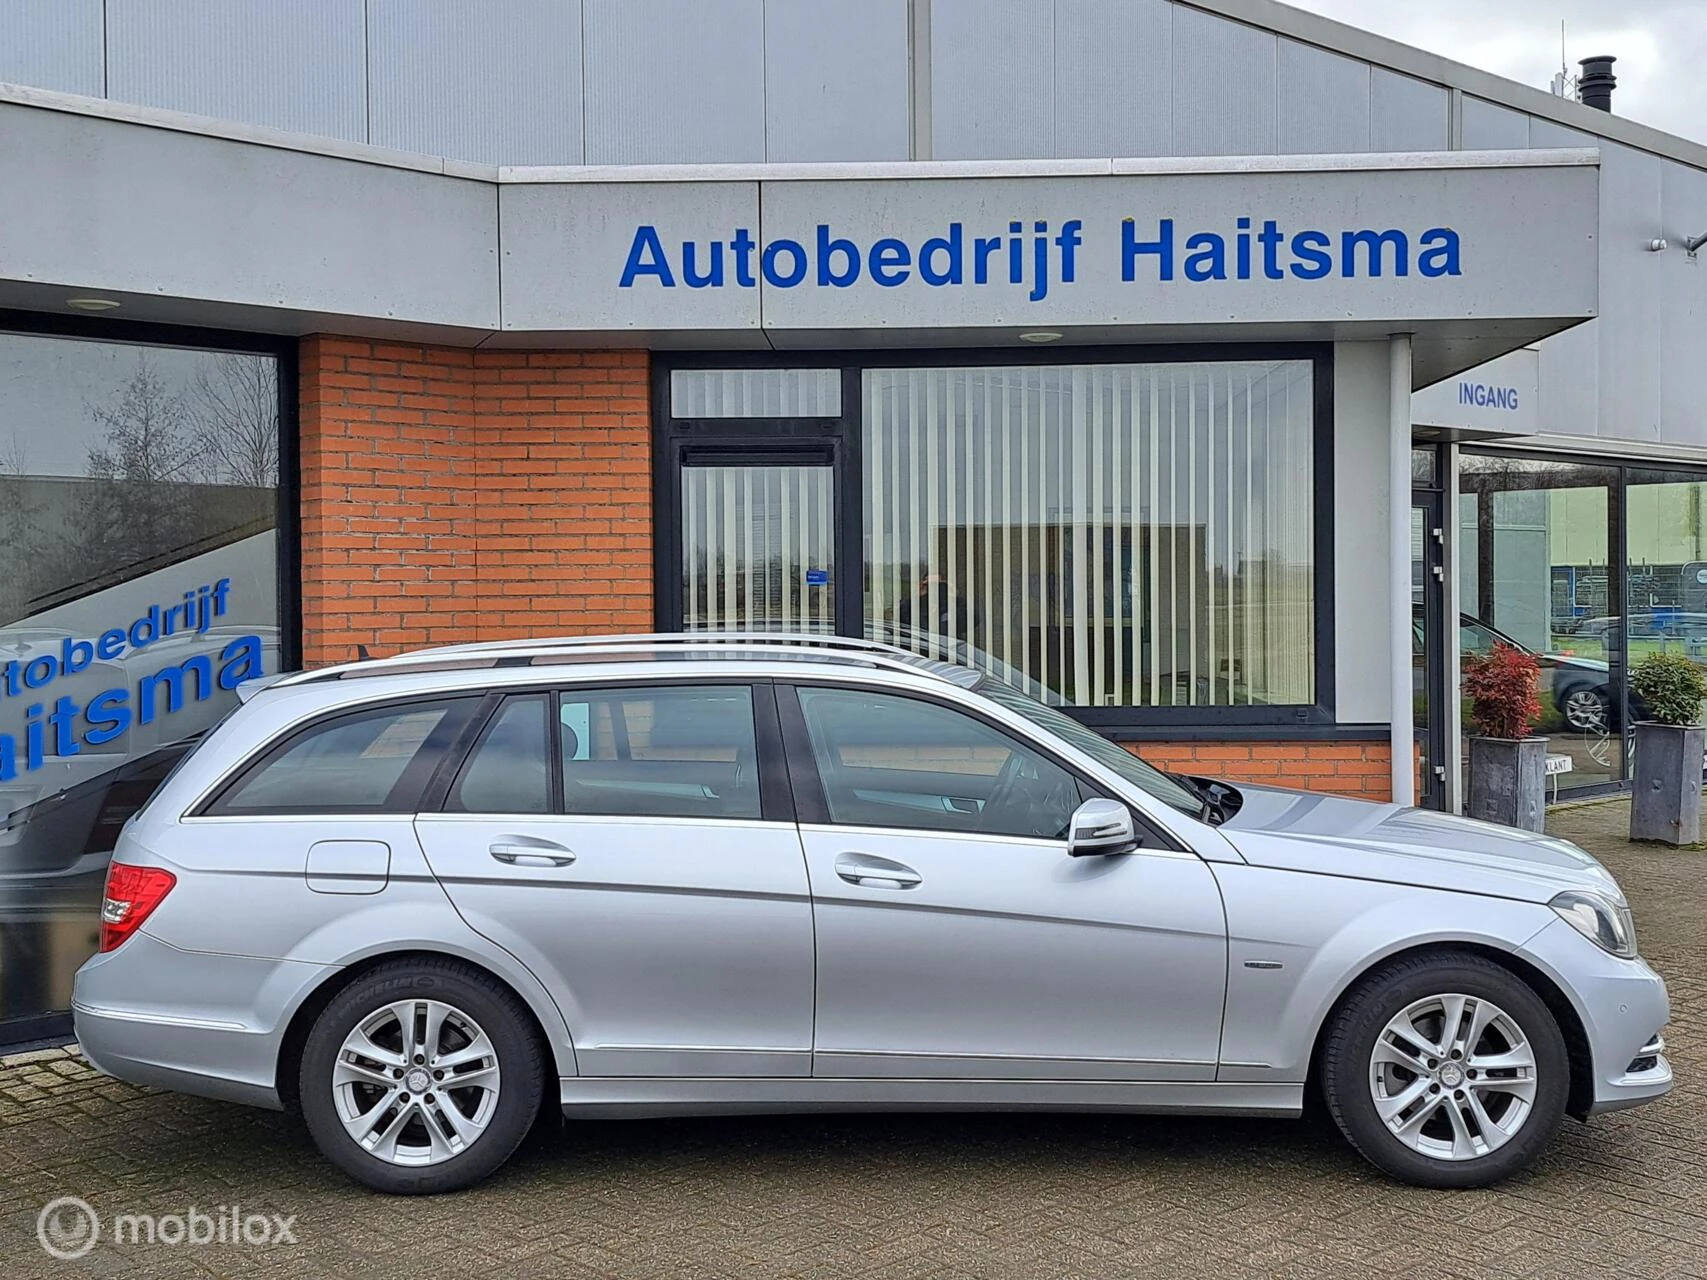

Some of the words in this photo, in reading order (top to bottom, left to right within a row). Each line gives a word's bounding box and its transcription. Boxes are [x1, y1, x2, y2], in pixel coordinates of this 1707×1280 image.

[618, 219, 1082, 302] Autobedrijf
[1121, 217, 1462, 283] Haitsma
[1459, 382, 1518, 410] INGANG
[0, 577, 231, 697] tobedrijf
